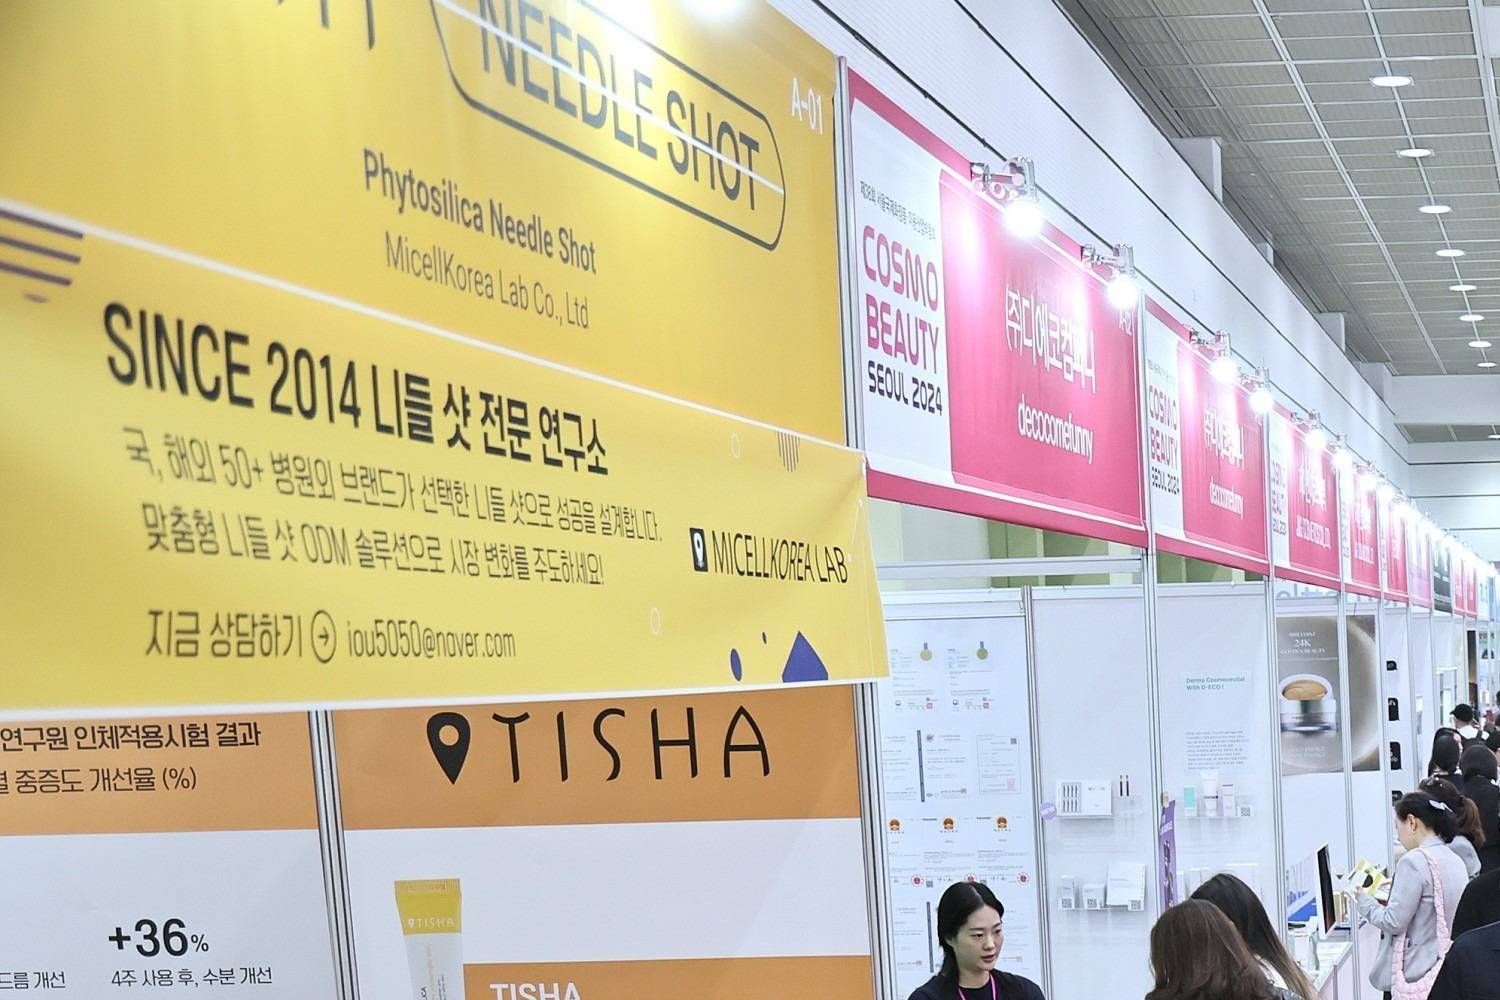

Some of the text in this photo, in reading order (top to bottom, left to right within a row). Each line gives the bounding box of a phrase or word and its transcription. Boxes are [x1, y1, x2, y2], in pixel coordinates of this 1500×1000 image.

[481, 0, 657, 160] NEEDLE
[666, 89, 761, 211] SHOT
[791, 76, 824, 134] A-01
[363, 147, 598, 275] Phytosilica Needle Shot
[385, 231, 590, 329] MicellKorea Lab Co., Ltd
[863, 225, 938, 312] COSMO
[866, 293, 939, 374] BEAUTY
[104, 302, 609, 475] SINCE 2014 니들 샷 전문 연구소
[868, 360, 942, 416] SEOUL 2024
[164, 432, 216, 484] 해외
[219, 445, 265, 489] 50+
[340, 462, 416, 511] 브랜드가
[420, 474, 470, 521] 선택한
[474, 483, 507, 525] 니들
[510, 489, 553, 530] 샷으로
[556, 497, 596, 535] 성공을
[141, 501, 605, 587] 맞춤형 니들 샷 ODM 솔루션으로 시장 변화를 주도하세요!
[712, 532, 848, 584] MICELLKOREA LAB
[144, 610, 200, 661] 지금
[209, 610, 304, 663] 상담하기
[1, 721, 262, 753] 연구원 인체적용시험 결과
[492, 704, 771, 784] TISHA
[15, 766, 197, 795] 중증도 개선율 (%)
[34, 971, 66, 989] 개선
[111, 966, 273, 988] 4주 사용 후, 수분 개선
